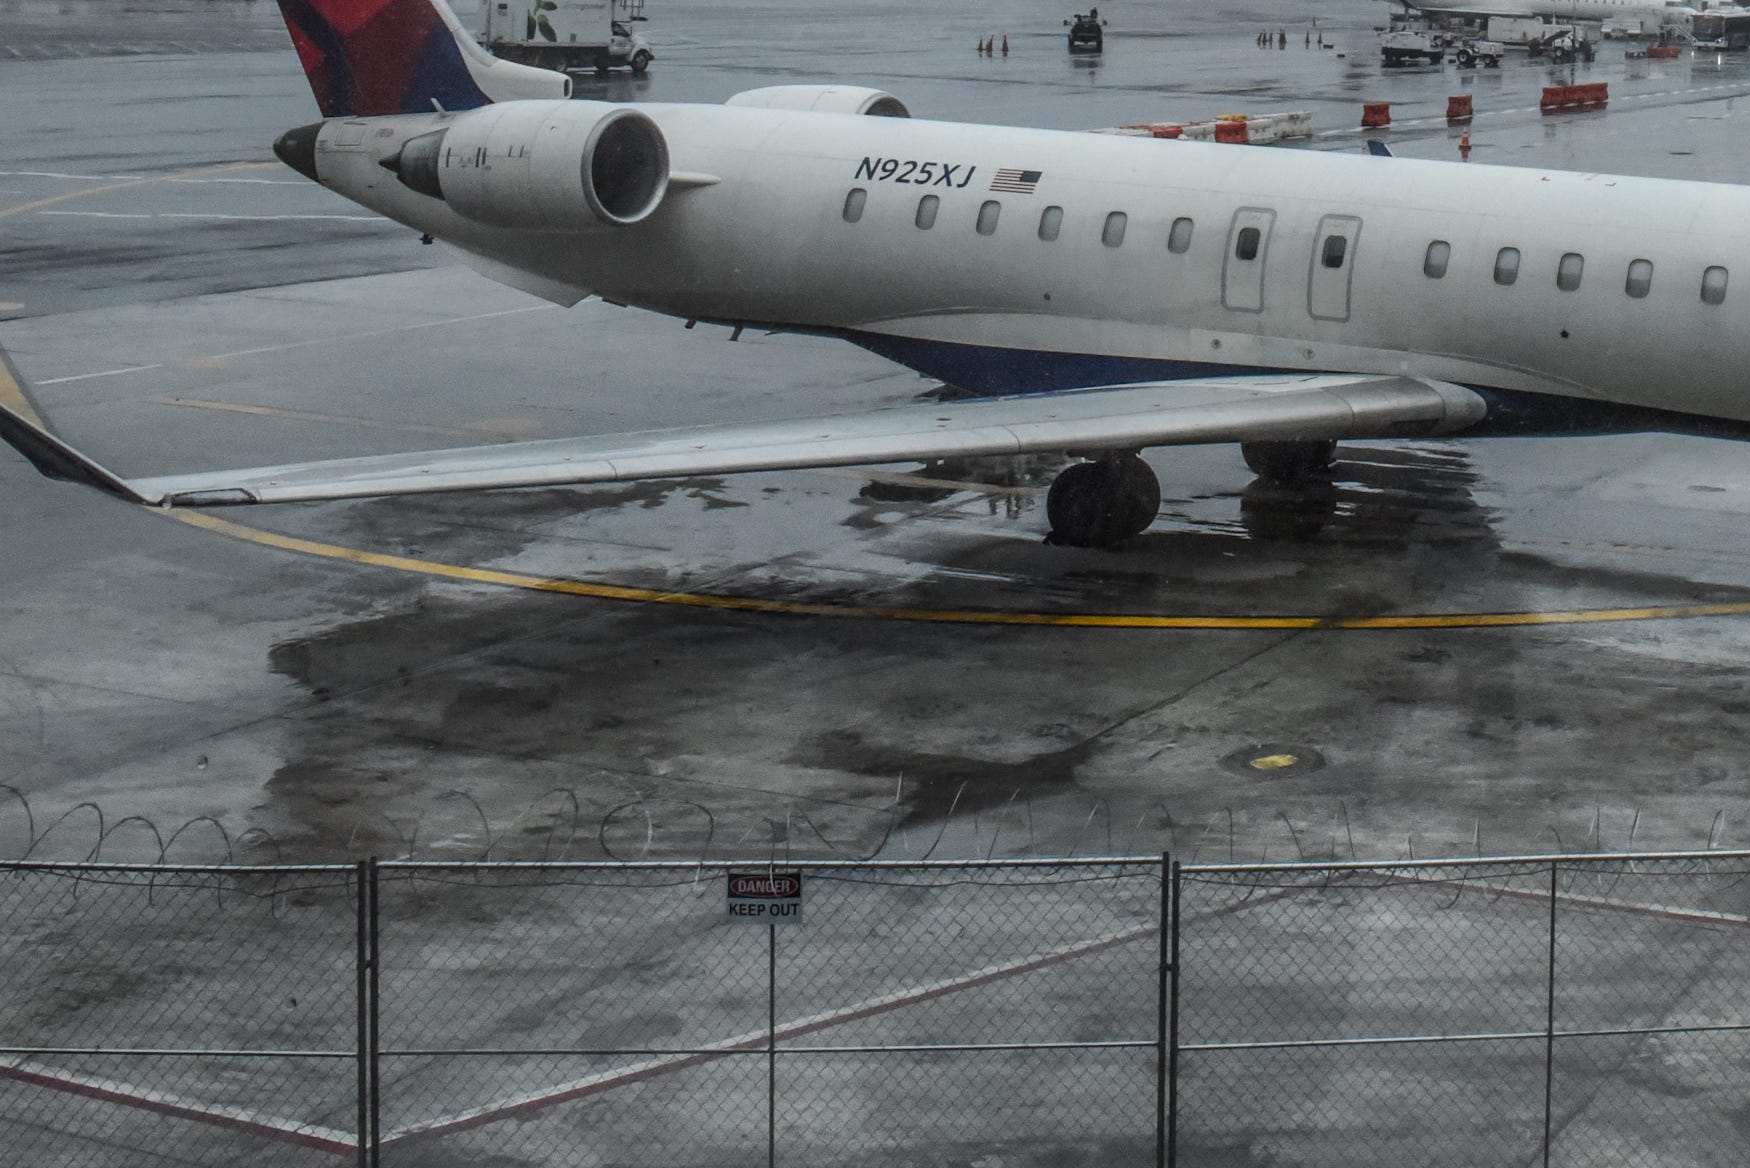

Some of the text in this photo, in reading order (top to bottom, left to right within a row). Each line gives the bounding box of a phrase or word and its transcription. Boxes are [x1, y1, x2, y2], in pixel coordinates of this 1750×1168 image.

[854, 156, 977, 188] N925XJ
[738, 880, 790, 893] DANGER
[729, 903, 800, 916] KEEP OUT
